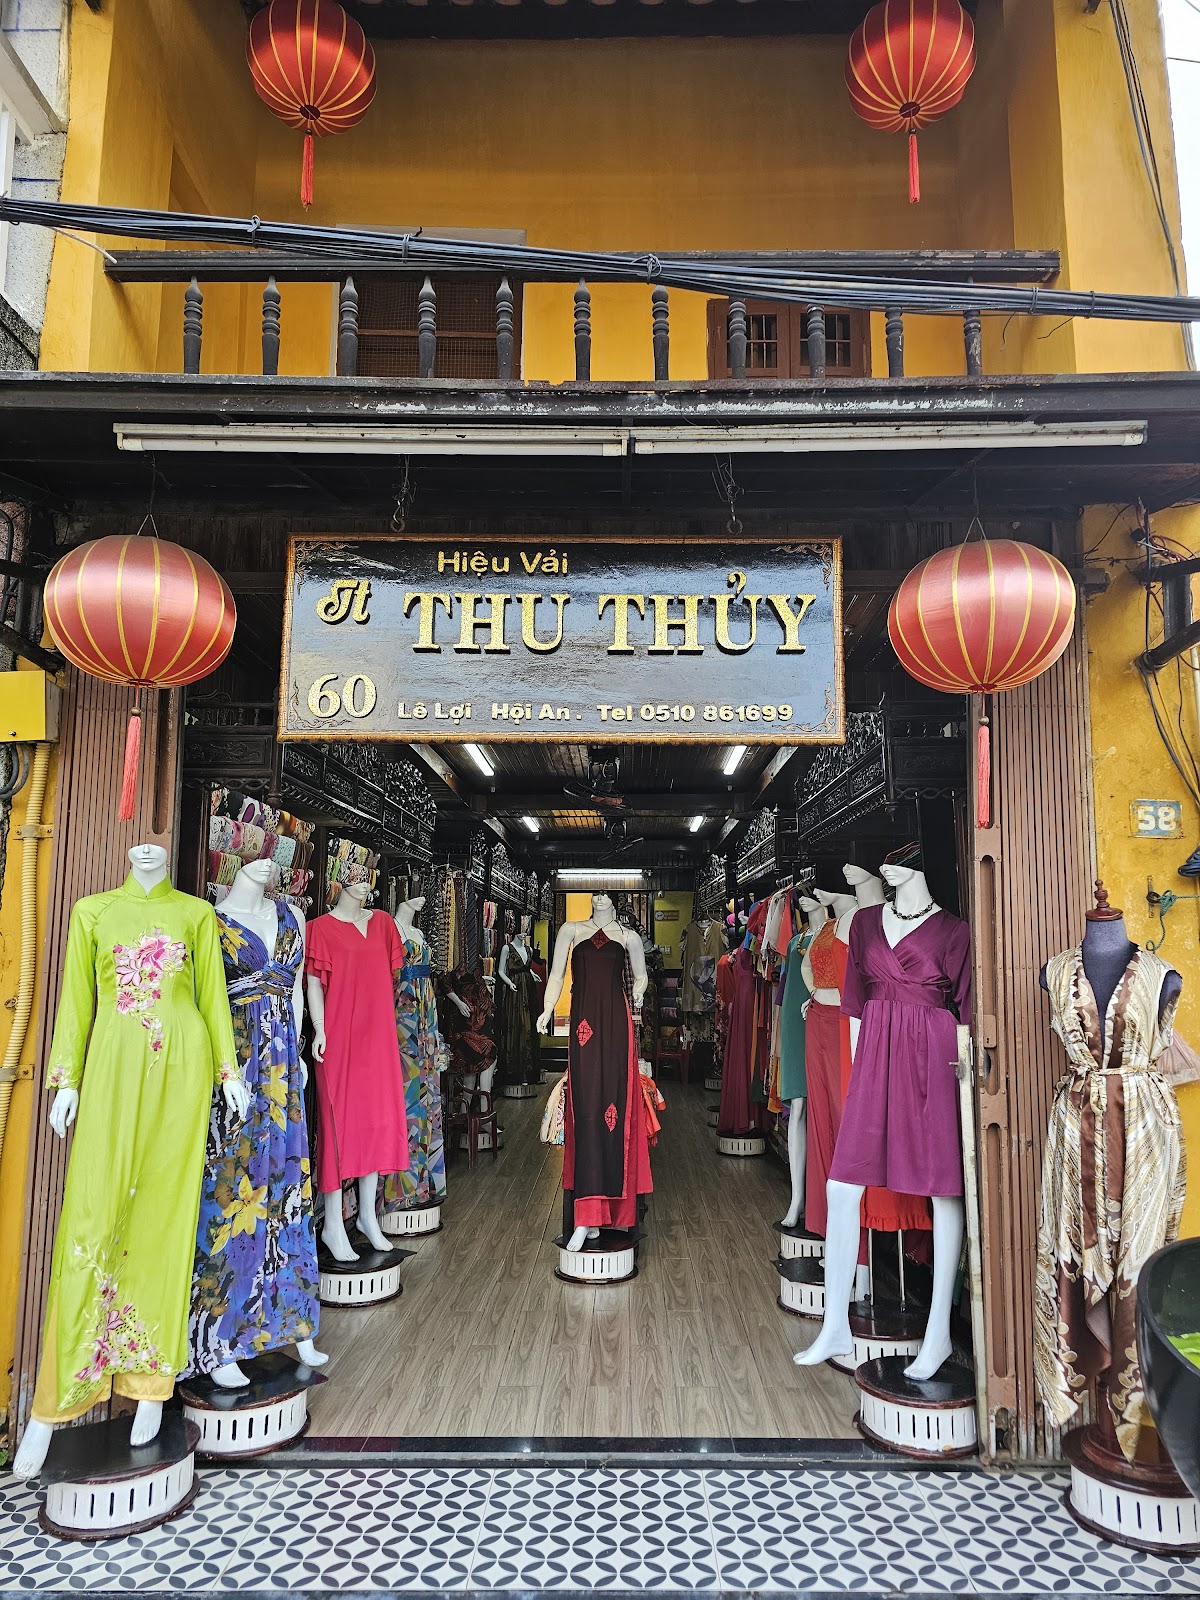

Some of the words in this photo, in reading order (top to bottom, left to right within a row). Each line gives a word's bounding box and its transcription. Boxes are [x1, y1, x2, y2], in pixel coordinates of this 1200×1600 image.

[437, 550, 510, 577] Hiệu
[519, 548, 568, 574] Vải
[403, 591, 571, 652] THU
[597, 570, 817, 652] THỦY
[307, 673, 377, 719] 60
[397, 702, 428, 719] Lê
[434, 702, 472, 725] Lợi
[491, 702, 532, 725] Hội
[596, 704, 633, 721] Tel
[640, 703, 696, 722] 0510
[702, 703, 794, 722] 861699
[1137, 805, 1177, 831] 58
